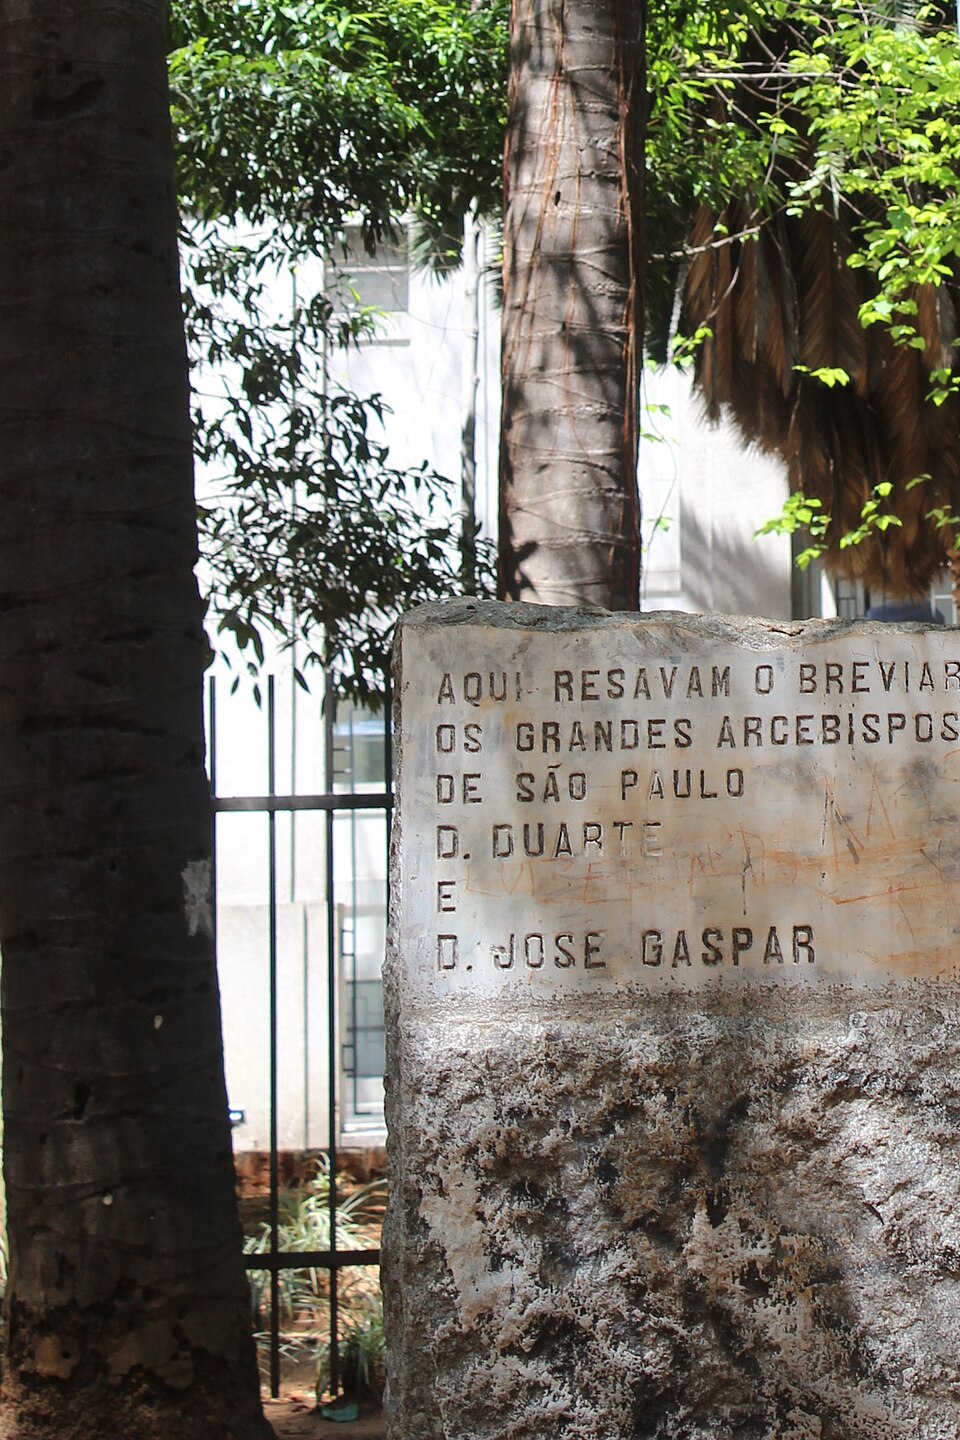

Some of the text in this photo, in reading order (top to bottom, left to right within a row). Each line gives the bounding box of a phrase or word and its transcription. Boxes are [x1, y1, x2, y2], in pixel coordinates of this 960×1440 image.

[437, 671, 522, 707] AQUI
[553, 665, 731, 703] RESAVAM
[755, 664, 774, 695] O
[436, 712, 960, 754] OS GRANDES ARCEBISPOS
[436, 763, 744, 804] DE SÃO PAULO
[492, 821, 664, 859] DUARTE
[436, 880, 457, 913] E
[493, 930, 608, 970] JOSE
[641, 925, 815, 968] GASPAR
